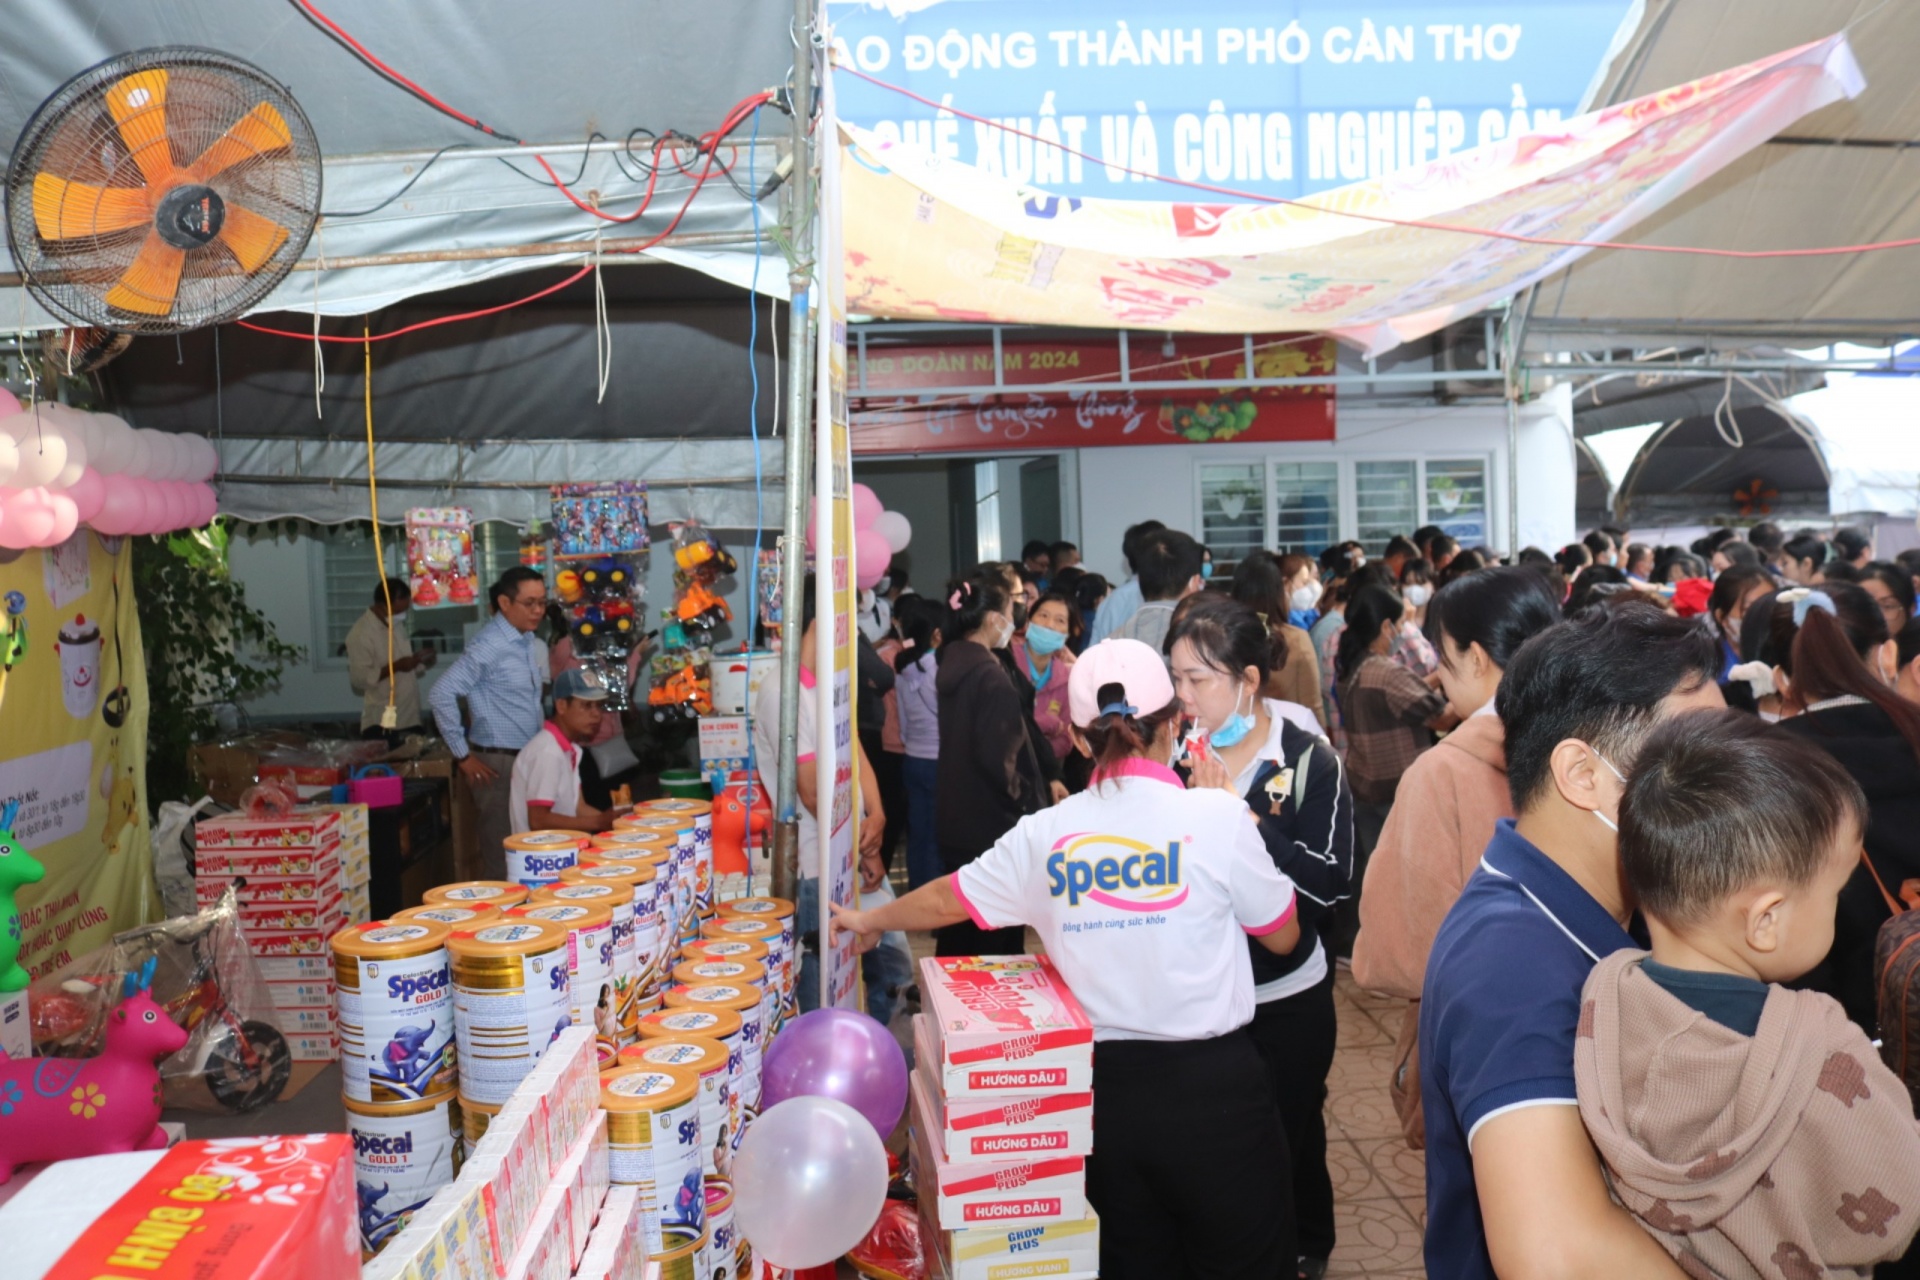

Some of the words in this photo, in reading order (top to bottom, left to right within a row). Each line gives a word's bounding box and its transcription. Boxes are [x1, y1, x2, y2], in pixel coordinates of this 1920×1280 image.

[902, 28, 1037, 79] ĐỘNG
[1048, 20, 1203, 67] THÀNH
[1426, 24, 1522, 62] THƠ
[974, 90, 1087, 185] XUẤT
[1100, 100, 1159, 183] VÀ
[1173, 99, 1293, 182] CÔNG
[902, 351, 966, 373] ĐOÀN
[1030, 351, 1080, 369] 2024
[524, 851, 575, 875] Specal
[1047, 841, 1181, 907] Specal
[1062, 922, 1081, 933] Đồng
[1083, 920, 1103, 930] hành
[1105, 918, 1125, 929] cùng
[1128, 916, 1143, 926] sức
[388, 962, 449, 1003] Specal
[415, 989, 442, 1005] GOLD
[942, 981, 1001, 1011] GROW
[983, 984, 1034, 1009] PLUS
[1003, 1034, 1040, 1050] GROW
[1004, 1047, 1035, 1061] PLUS
[981, 1072, 1027, 1086] HƯƠNG
[1029, 1070, 1056, 1084] DÂU
[1003, 1098, 1040, 1115] GROW
[1005, 1111, 1036, 1126] PLUS
[352, 1128, 413, 1157] Specal
[983, 1136, 1028, 1151] HƯƠNG
[1030, 1134, 1057, 1148] DÂU
[368, 1155, 398, 1164] GOLD
[401, 1154, 408, 1163] 1
[995, 1164, 1032, 1181] GROW
[996, 1176, 1027, 1191] PLUS
[976, 1203, 1021, 1218] HƯƠNG
[1023, 1201, 1050, 1215] DÂU
[1008, 1226, 1045, 1242] GROW
[1009, 1238, 1040, 1253] PLUS
[996, 1267, 1034, 1277] HƯƠNG
[1036, 1264, 1062, 1273] VANI
